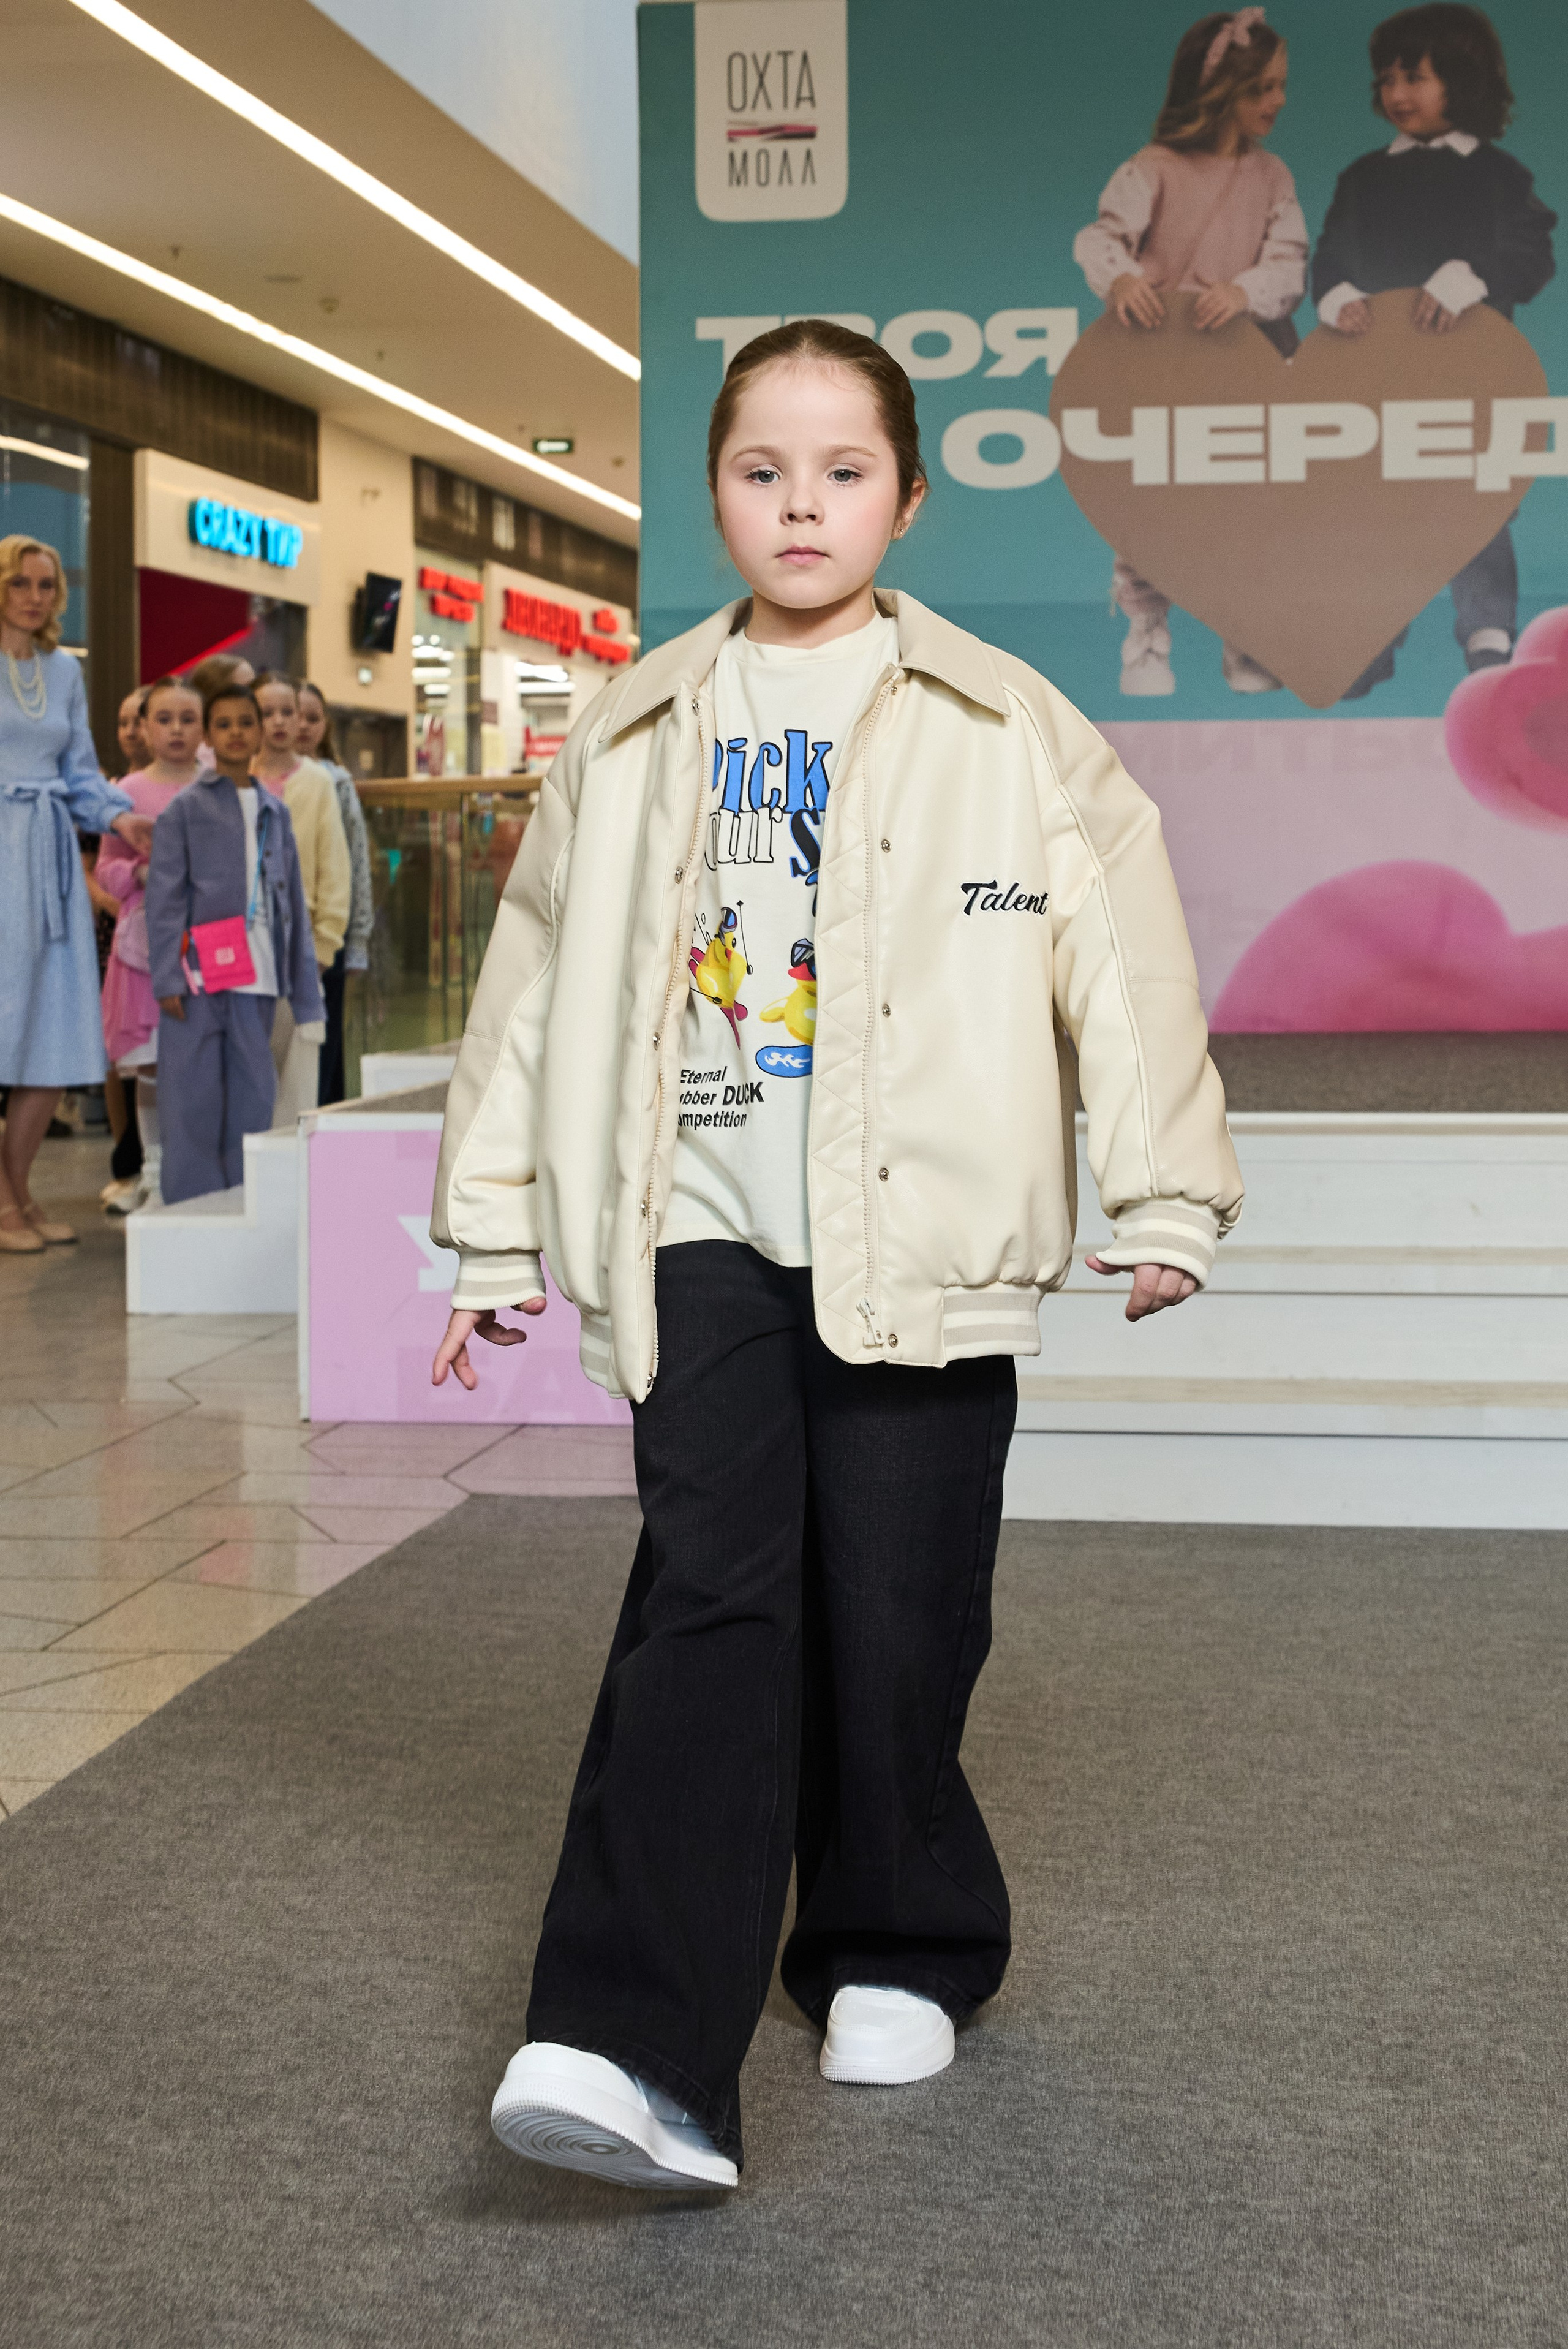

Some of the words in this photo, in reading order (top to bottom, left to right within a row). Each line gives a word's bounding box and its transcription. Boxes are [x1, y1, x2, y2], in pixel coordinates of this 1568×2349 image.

[727, 50, 816, 112] ОХТА
[728, 148, 816, 187] МОЛЛ
[695, 308, 1079, 380] ТОЯ
[193, 496, 263, 559] CRAZY
[712, 728, 833, 818] ick
[704, 805, 783, 871] our
[960, 879, 1049, 916] Talent
[680, 1065, 728, 1084] Eternal
[722, 1081, 764, 1106] DUCK
